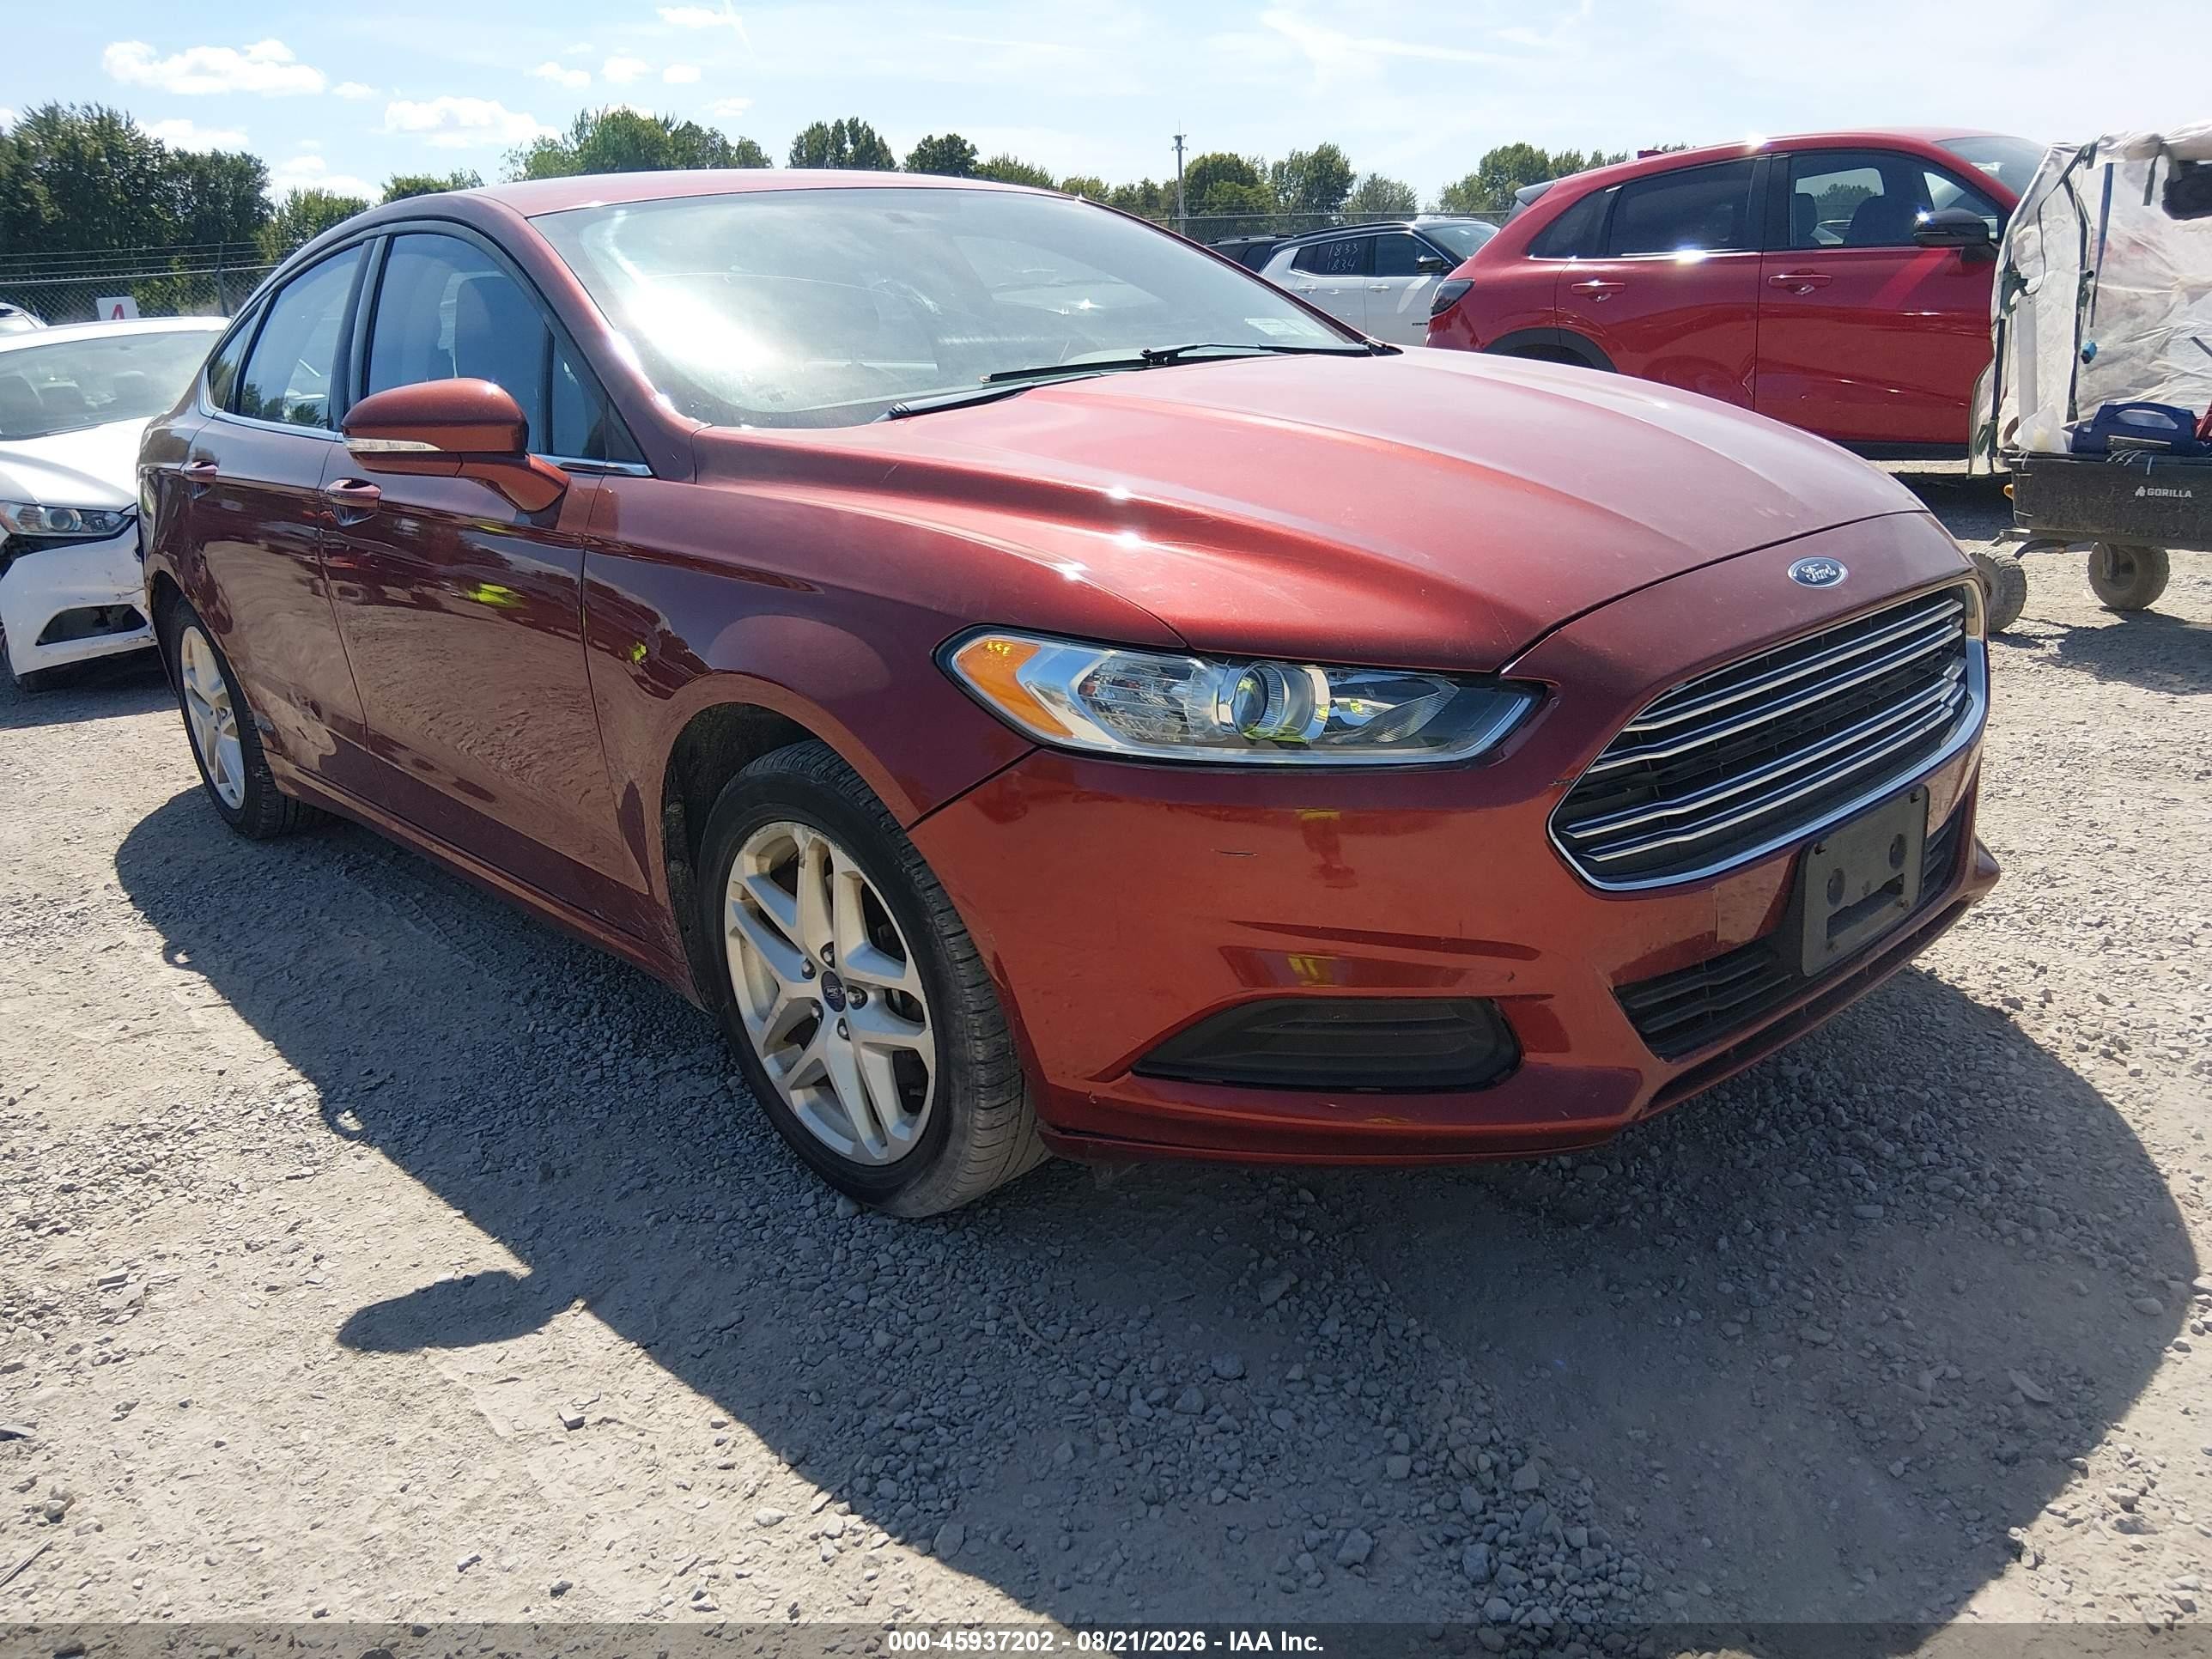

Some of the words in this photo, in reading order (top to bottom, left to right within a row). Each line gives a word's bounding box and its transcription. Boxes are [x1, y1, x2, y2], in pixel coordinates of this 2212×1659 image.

[1328, 243, 1358, 259] 1833
[1326, 258, 1357, 273] 1834
[2147, 488, 2192, 498] GORILLA
[1801, 563, 1837, 582] Ford
